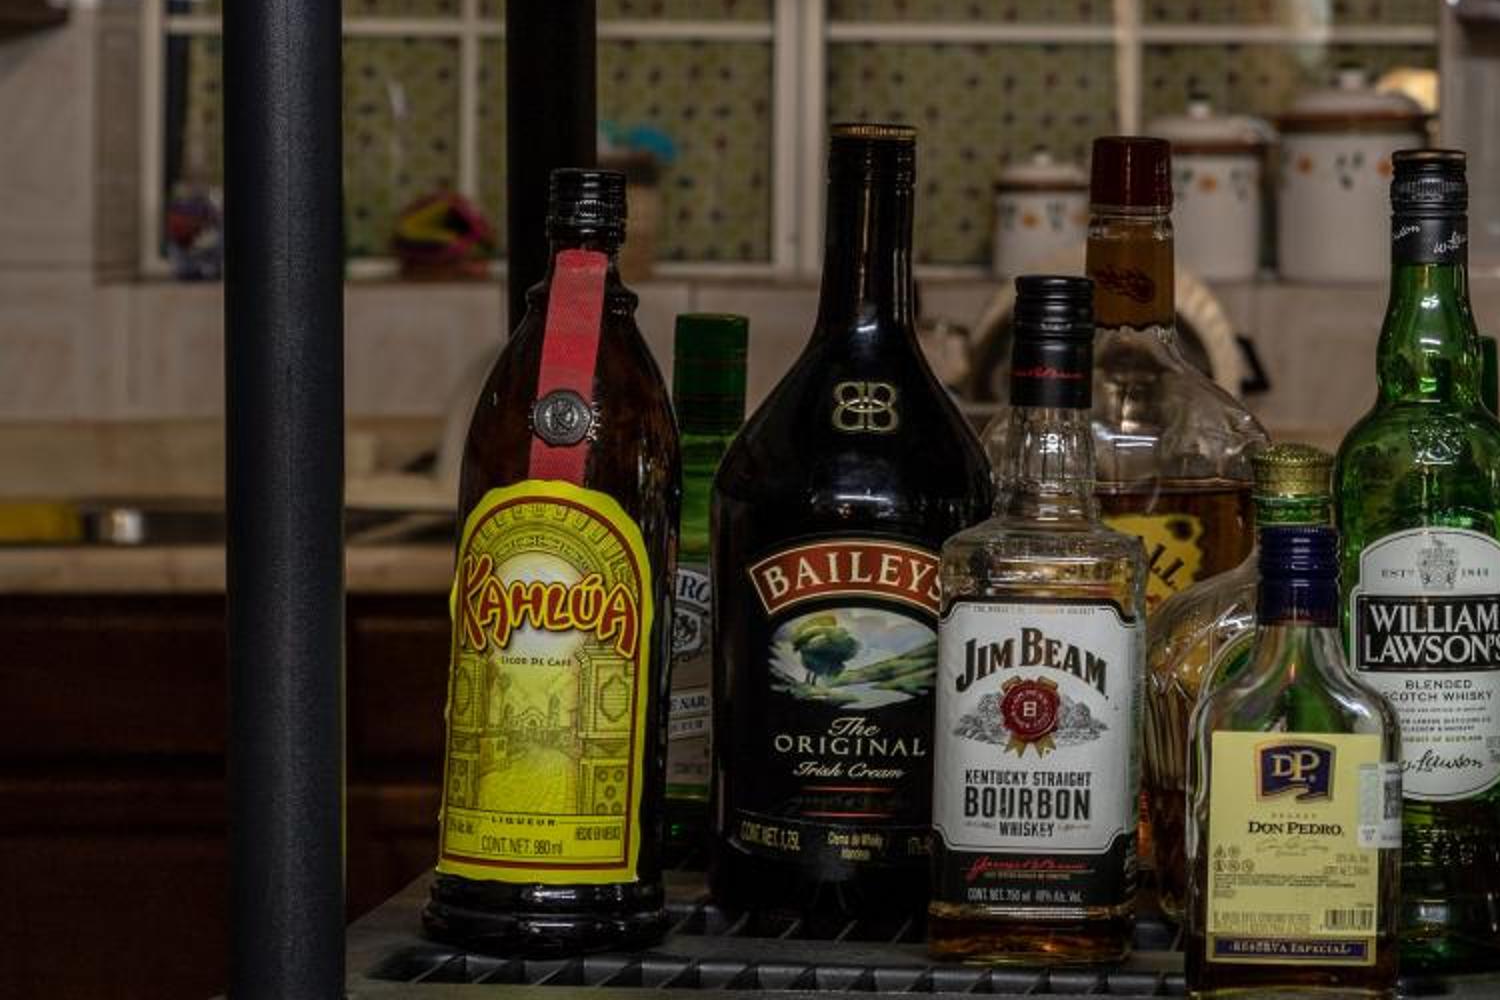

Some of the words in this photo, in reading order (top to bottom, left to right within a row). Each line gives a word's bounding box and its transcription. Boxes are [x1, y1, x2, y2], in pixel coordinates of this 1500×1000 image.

[763, 549, 944, 601] BAILEYS
[462, 551, 638, 659] KAHLÚA
[1369, 604, 1499, 633] WILLIAM
[956, 638, 1015, 693] JIM
[1404, 679, 1473, 690] BLENDED
[1443, 690, 1493, 702] WHISKY
[828, 717, 882, 737] The
[774, 734, 927, 757] ORIGINAL
[792, 761, 845, 778] Irish
[965, 769, 1028, 786] KENTUCKY
[1032, 771, 1092, 787] STRAIGHT
[964, 787, 1091, 821] BOURBON
[998, 821, 1055, 837] WHISKEY
[1249, 821, 1285, 835] DON
[1286, 821, 1343, 836] PEDRO
